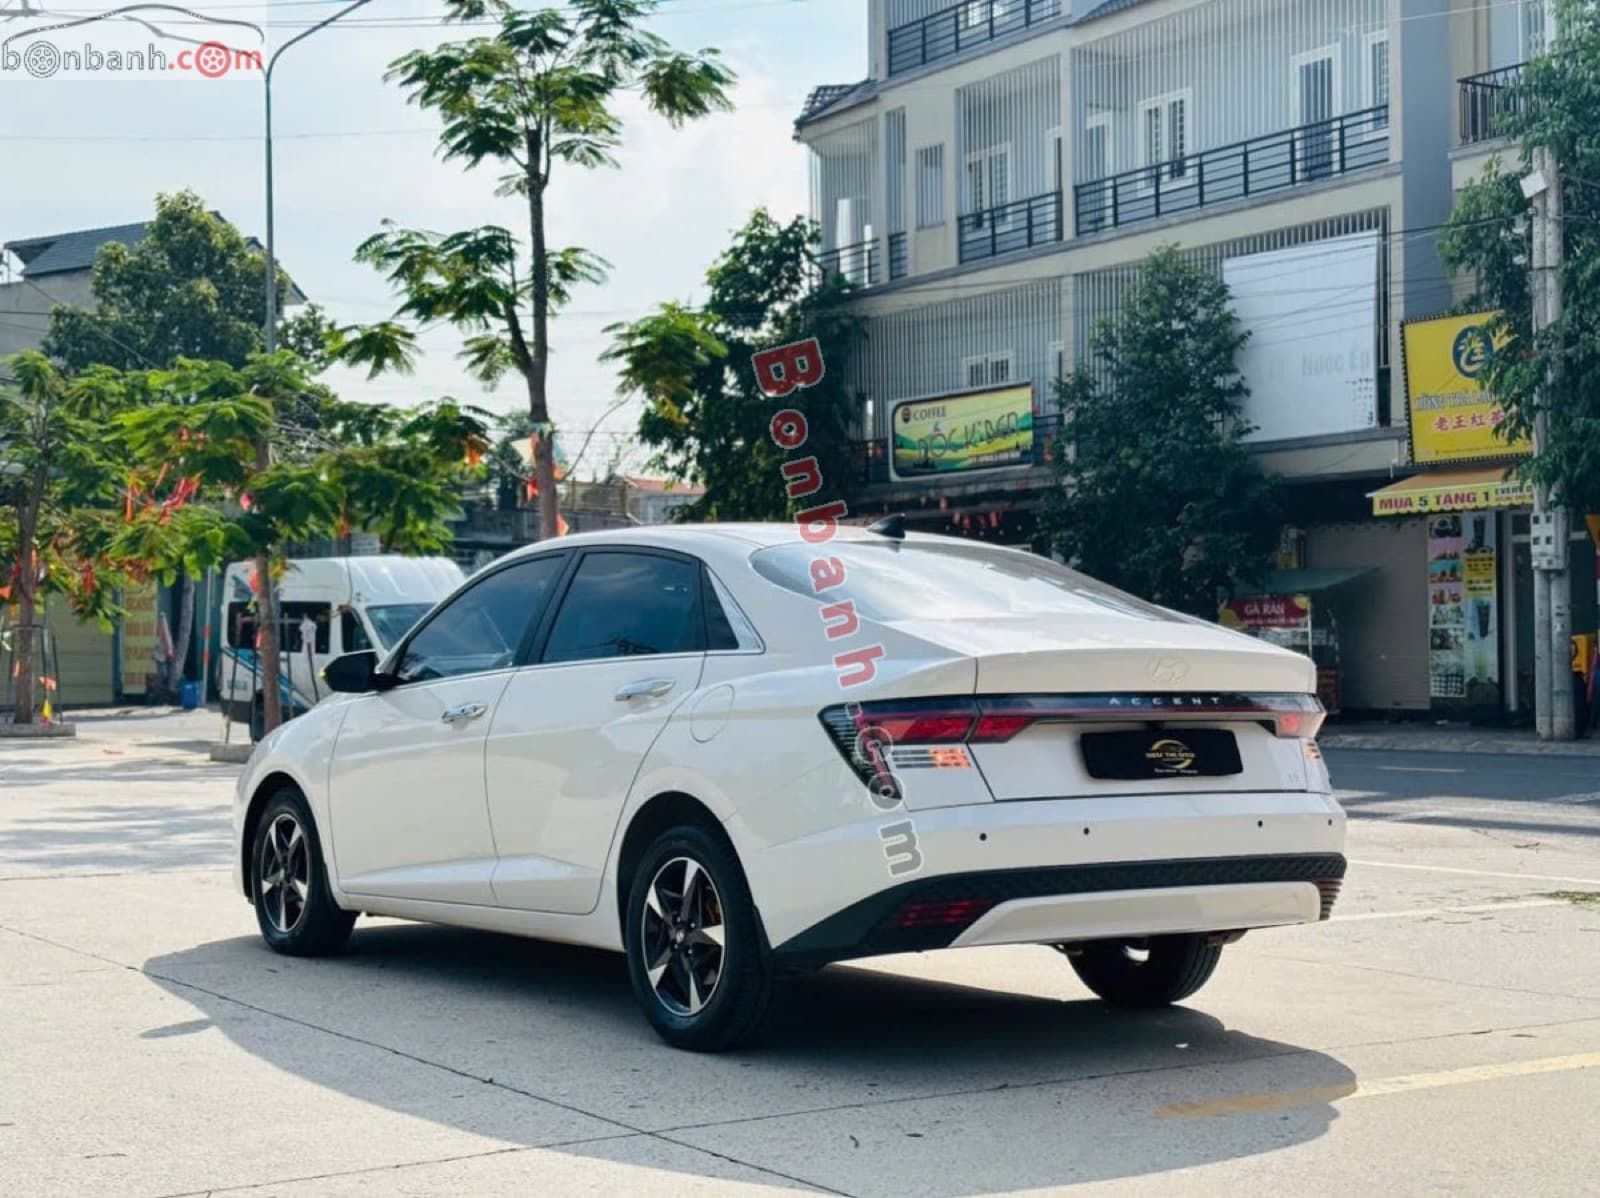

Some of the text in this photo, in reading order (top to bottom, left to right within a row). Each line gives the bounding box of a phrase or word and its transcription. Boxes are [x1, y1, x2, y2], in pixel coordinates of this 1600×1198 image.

[913, 406, 946, 421] COFFEE
[1379, 497, 1413, 510] MUA
[1418, 496, 1428, 506] 5
[1482, 491, 1489, 502] 1
[1109, 696, 1222, 705] ACCENT
